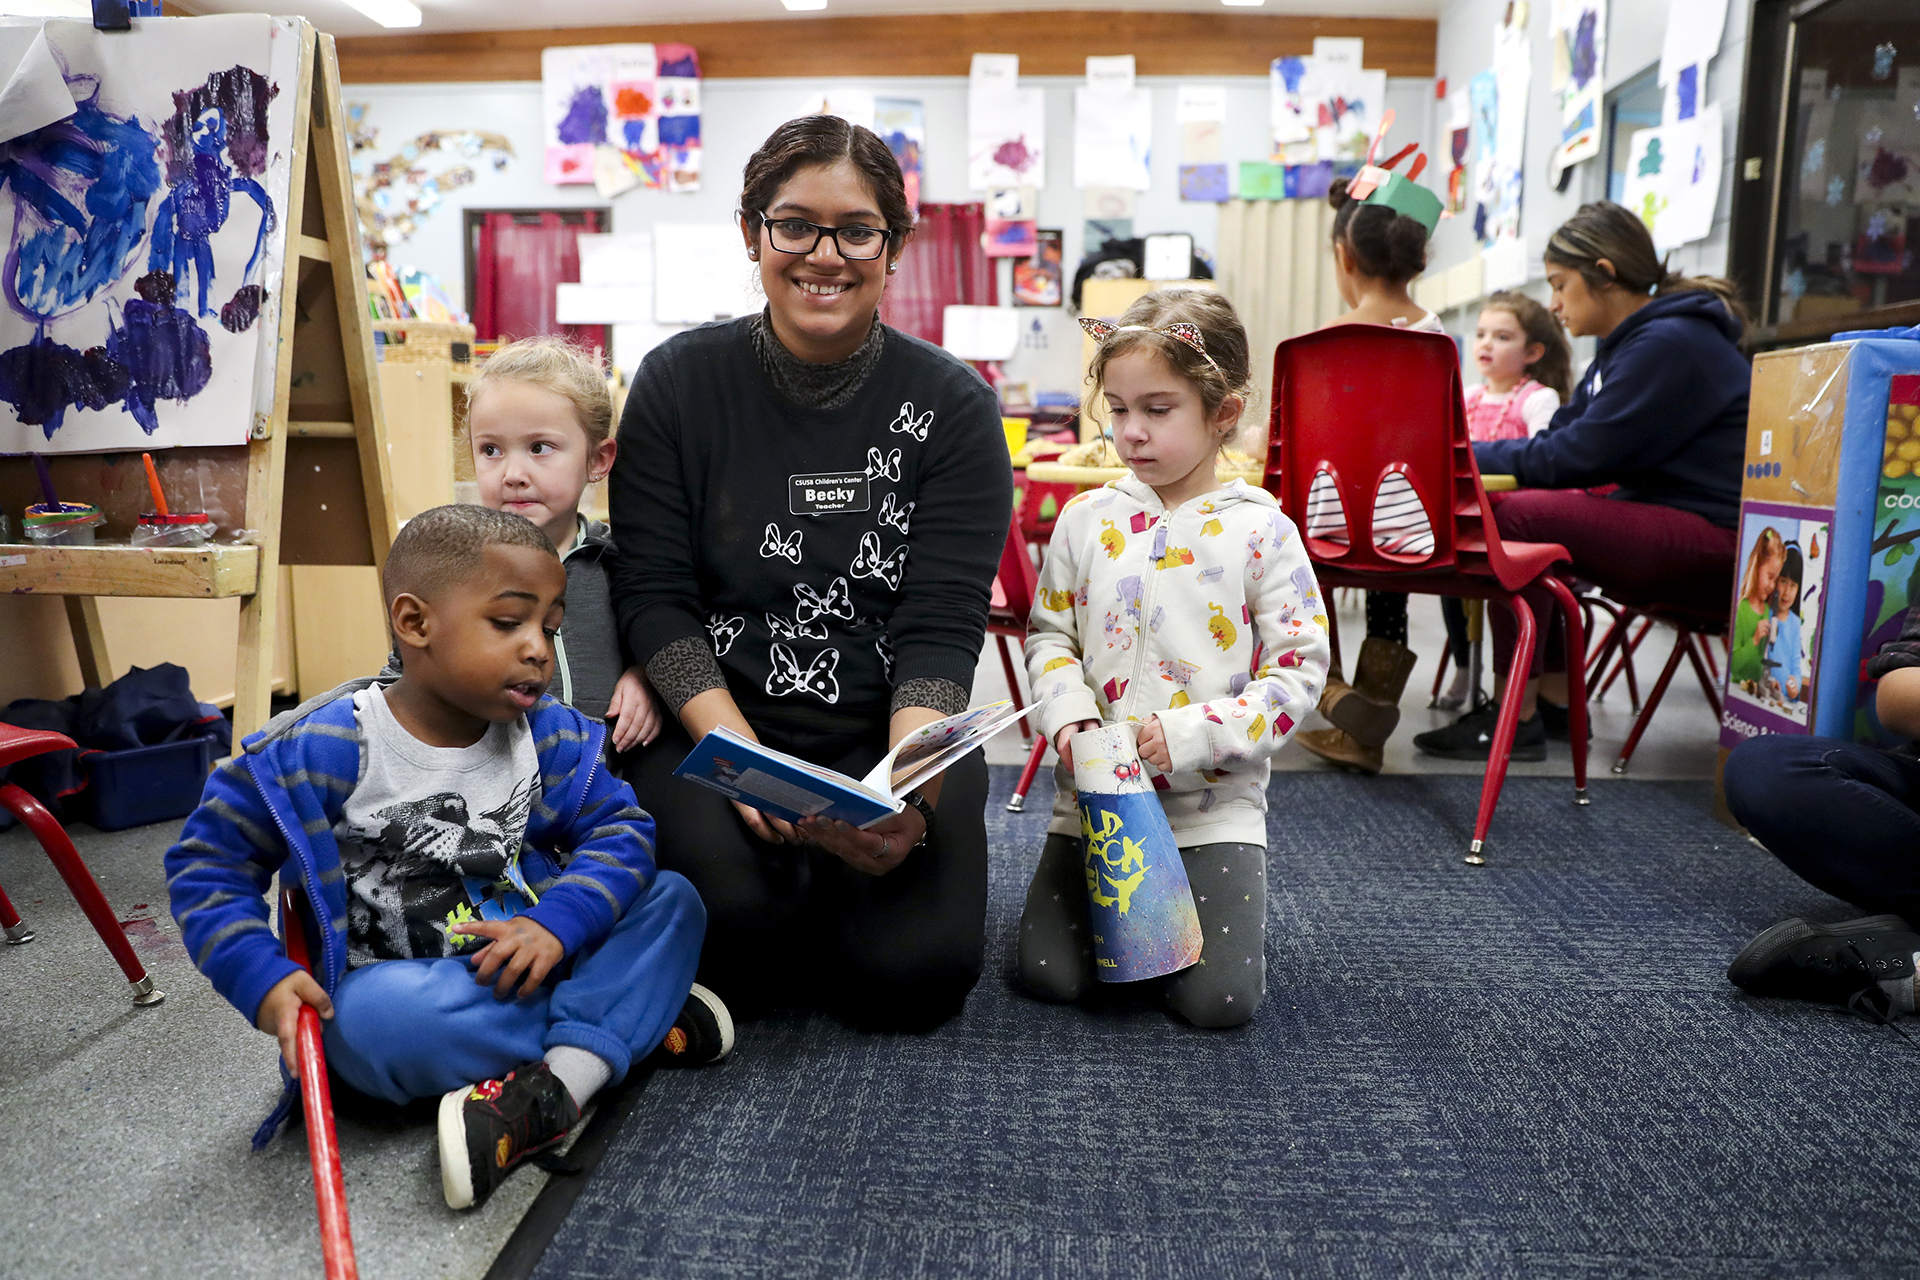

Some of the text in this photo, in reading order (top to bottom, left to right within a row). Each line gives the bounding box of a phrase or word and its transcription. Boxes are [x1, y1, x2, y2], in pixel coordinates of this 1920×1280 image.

[815, 477, 843, 485] Children's
[844, 476, 863, 484] Center
[805, 487, 855, 502] Becky
[1722, 710, 1758, 738] Science
